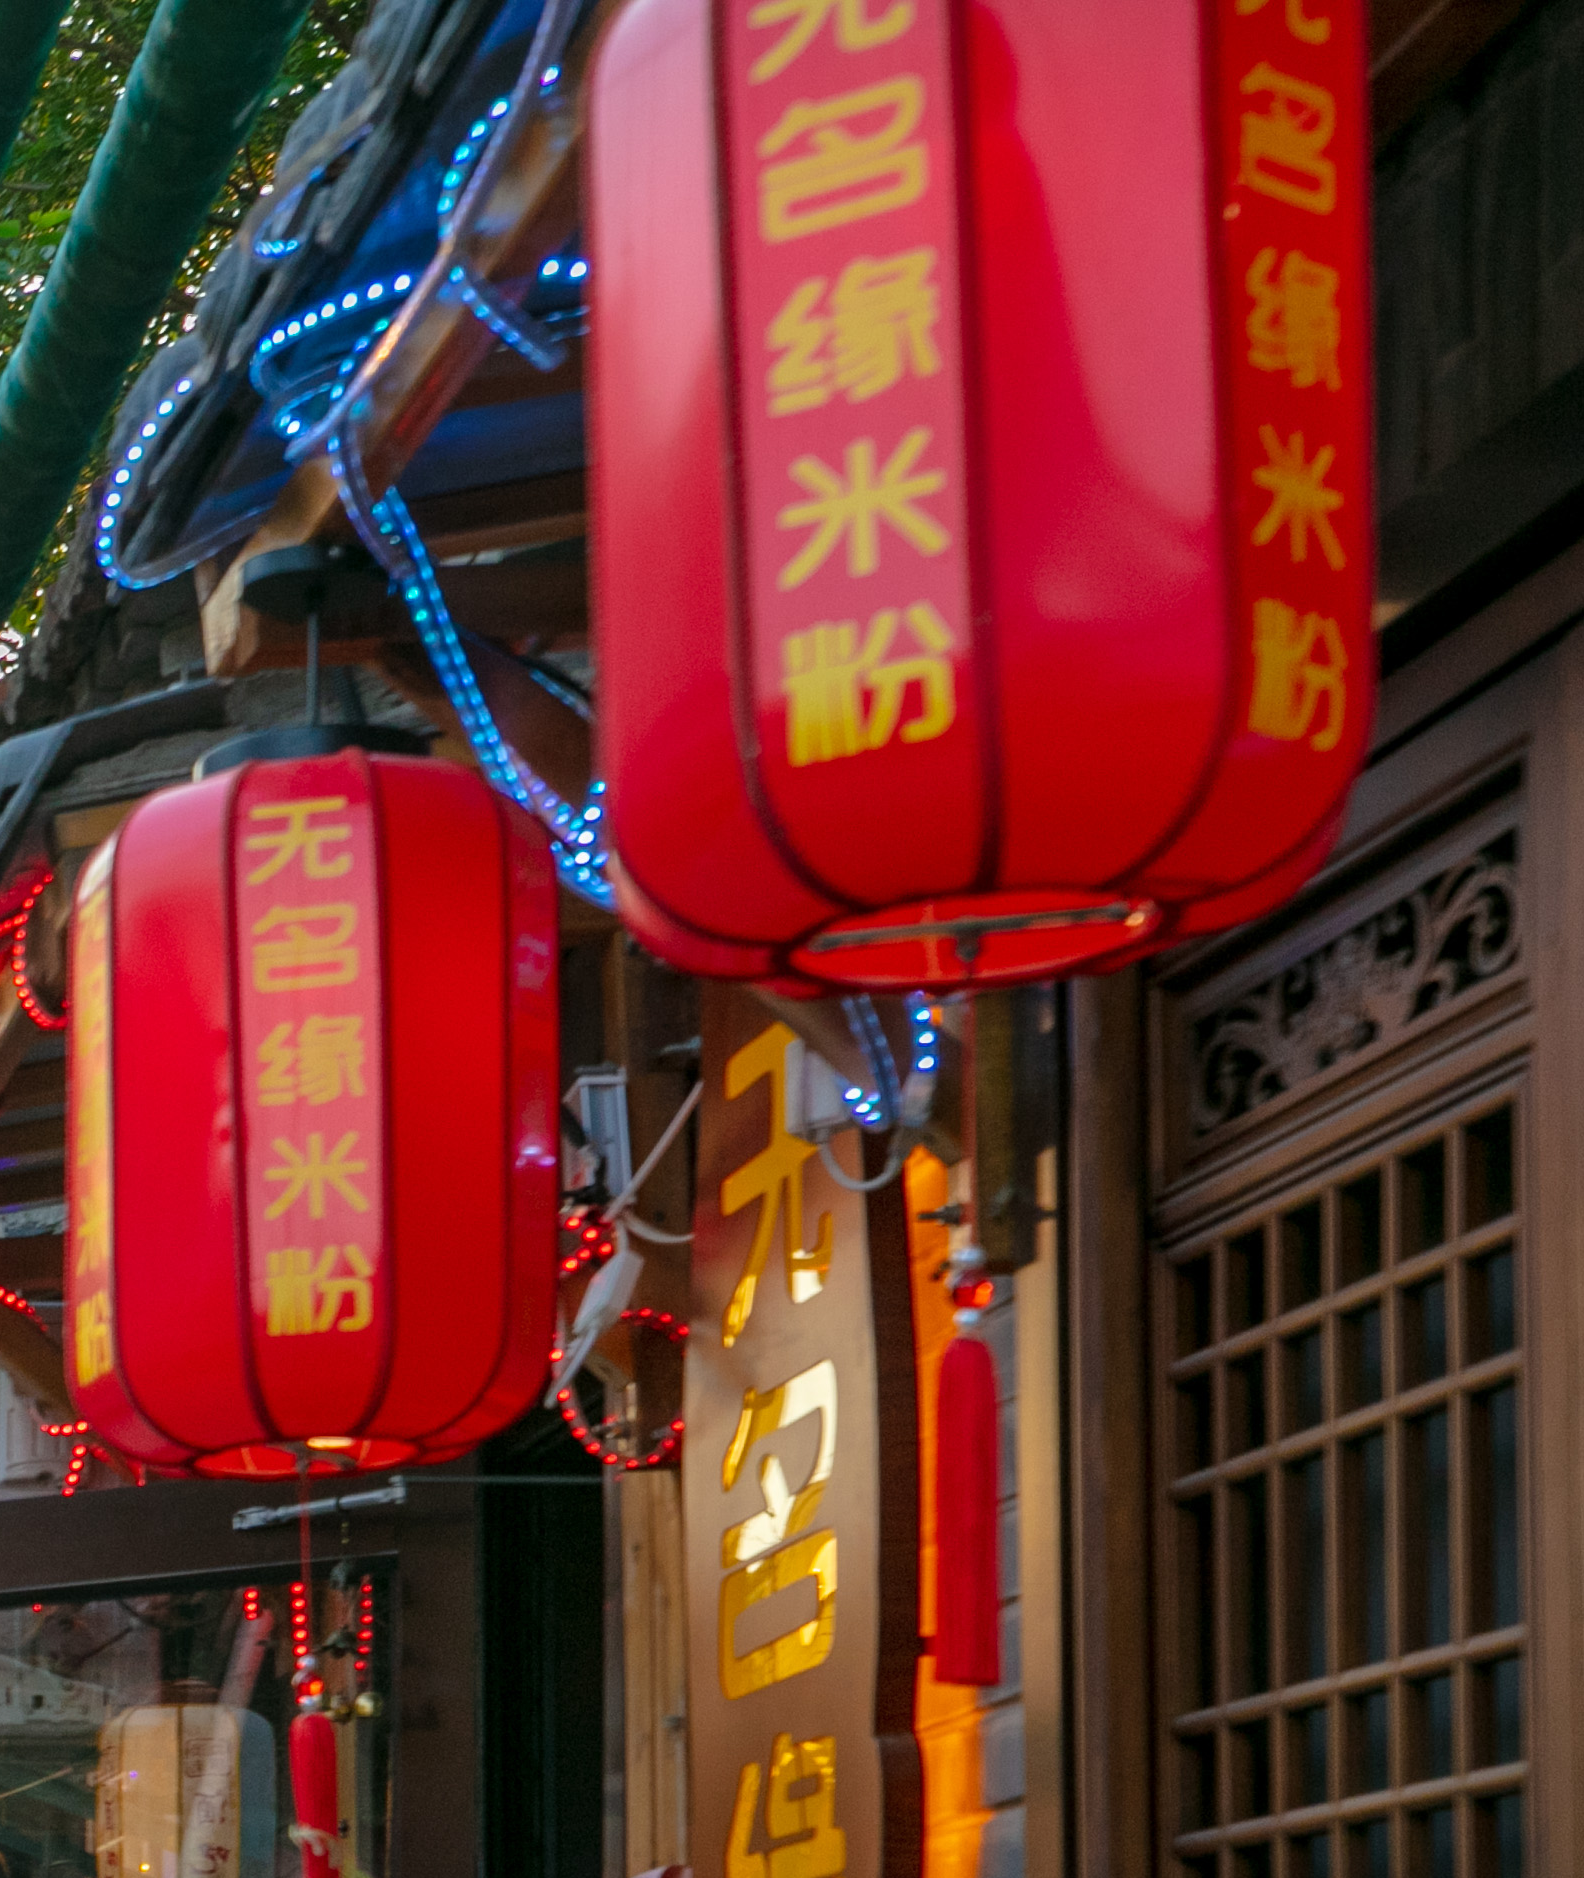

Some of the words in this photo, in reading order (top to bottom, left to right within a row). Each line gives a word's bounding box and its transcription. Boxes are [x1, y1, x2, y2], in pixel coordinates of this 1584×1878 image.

[248, 797, 374, 1337] 无名缘米粉
